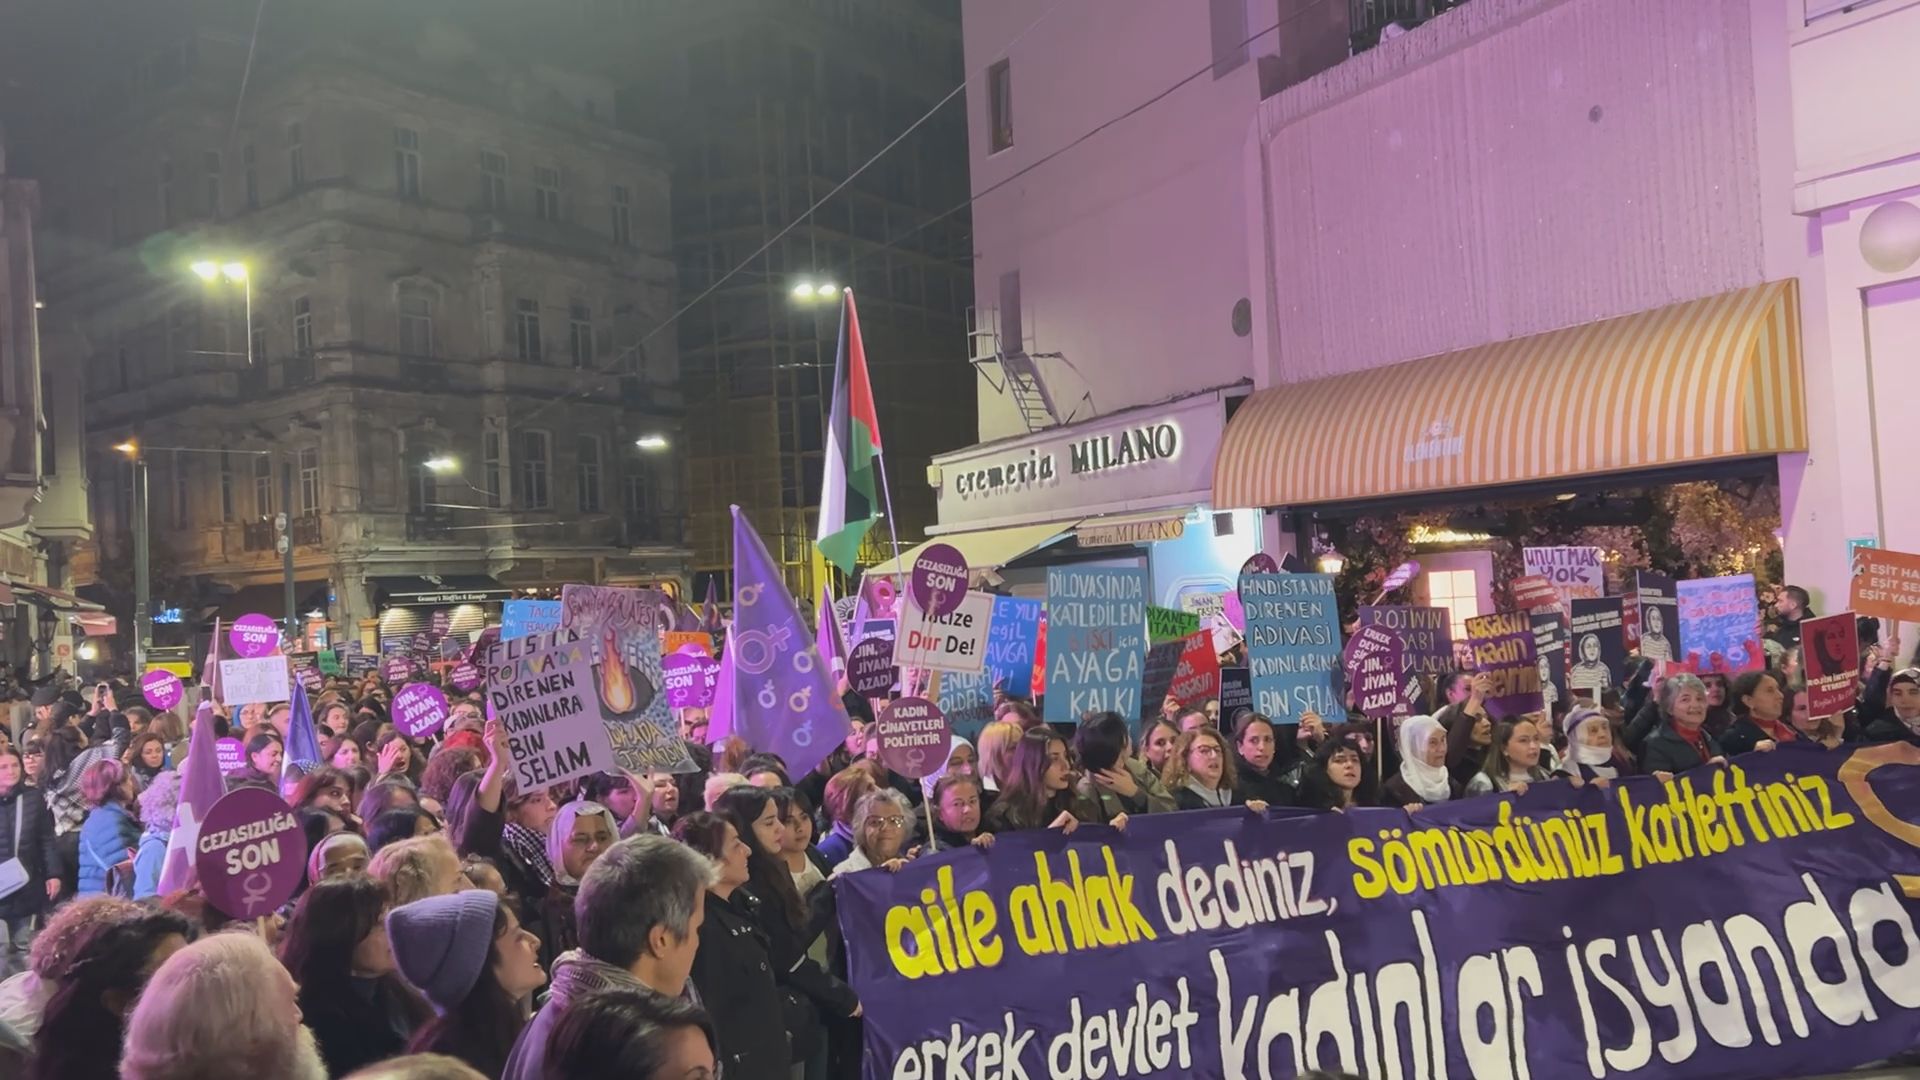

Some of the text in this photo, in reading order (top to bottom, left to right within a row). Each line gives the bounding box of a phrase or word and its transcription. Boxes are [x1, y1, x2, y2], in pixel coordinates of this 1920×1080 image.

[956, 424, 1177, 495] cremeria MILANO
[1116, 519, 1184, 542] MILANO
[916, 558, 968, 579] CEZASIZLIĞA
[1870, 563, 1898, 576] EŞİT
[926, 573, 956, 592] SON
[1871, 577, 1898, 589] EŞİT
[1859, 588, 1887, 601] EŞİT
[1050, 601, 1142, 627] KATLEDİLEN
[242, 633, 268, 644] SON
[908, 630, 942, 651] Dur
[945, 635, 975, 655] De!
[1119, 636, 1139, 649] için
[987, 642, 1028, 664] AVGA
[153, 684, 173, 698] SON
[665, 674, 693, 690] SON
[500, 695, 583, 733] KADINLARA
[893, 705, 928, 719] KADIN
[878, 716, 945, 735] CİNAYETLERİ
[884, 732, 942, 749] POLİTİKTİR
[519, 741, 592, 788] SELAM
[199, 811, 298, 854] CEZASIZLIĞA
[226, 838, 281, 875] SON
[884, 864, 1004, 979] aile
[1010, 844, 1157, 956] ahlak
[1156, 838, 1339, 935] dediniz,
[1619, 764, 1856, 869] katlettiniz
[892, 1011, 1035, 1080] erkek
[1047, 976, 1199, 1080] devlet
[1209, 909, 1544, 1080] kadınlar
